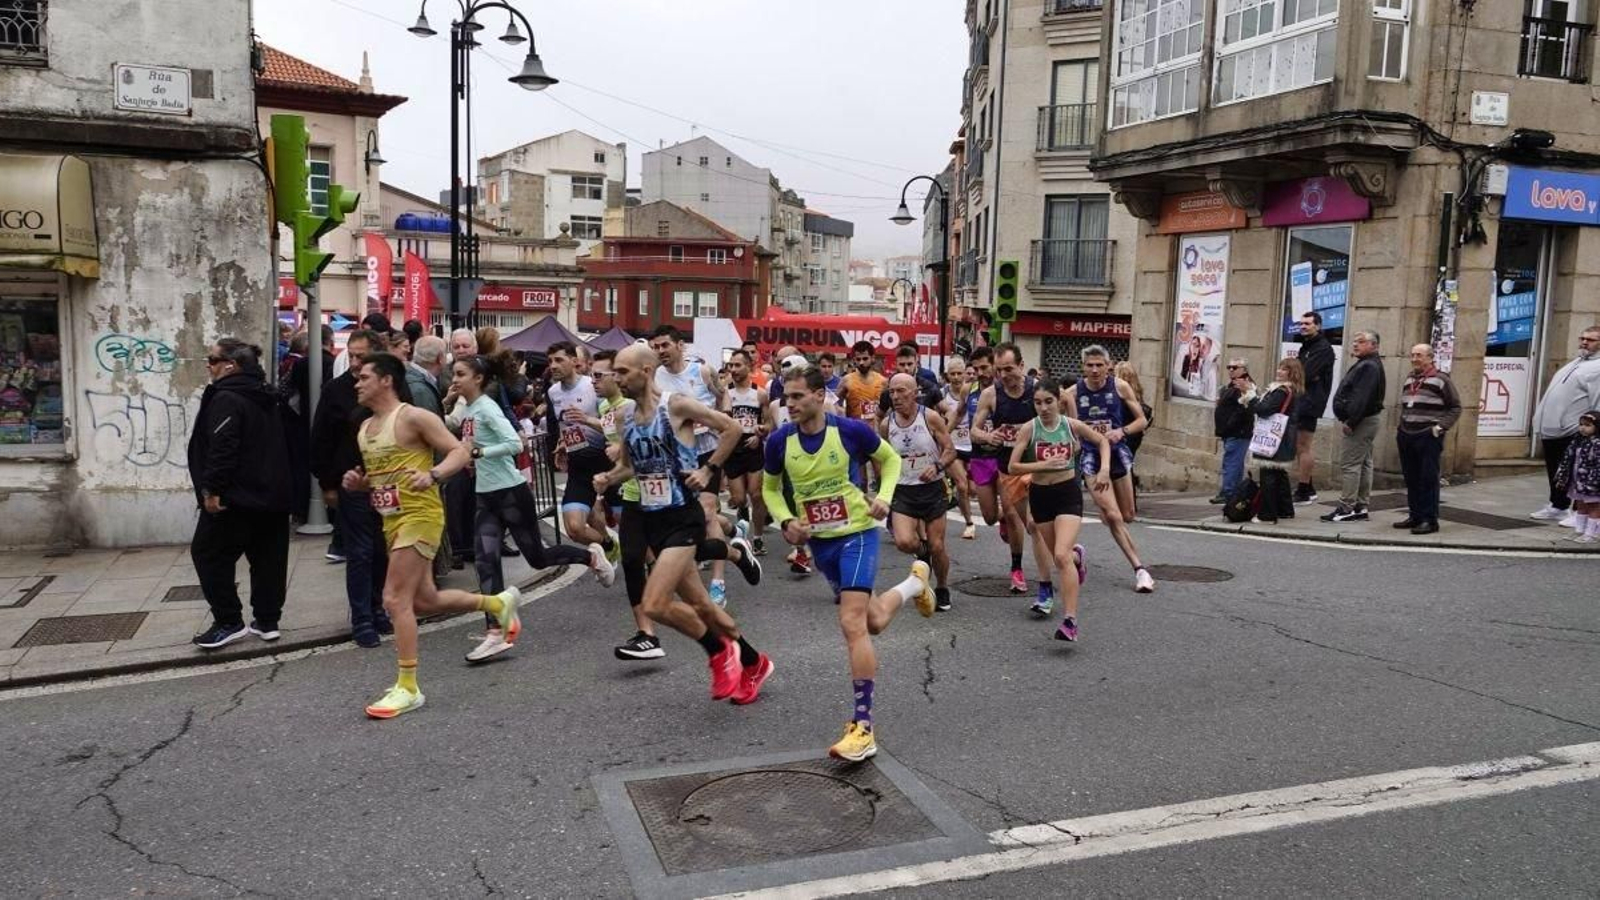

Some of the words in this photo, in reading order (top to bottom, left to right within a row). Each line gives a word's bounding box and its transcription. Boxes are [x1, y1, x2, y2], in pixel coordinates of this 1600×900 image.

[152, 84, 166, 94] de
[1531, 180, 1586, 211] lava
[1200, 259, 1226, 273] lava
[524, 292, 553, 302] FROIZ
[1070, 321, 1132, 334] MAPFRE
[1042, 446, 1069, 460] 612
[648, 480, 664, 496] 21
[812, 503, 842, 522] 582
